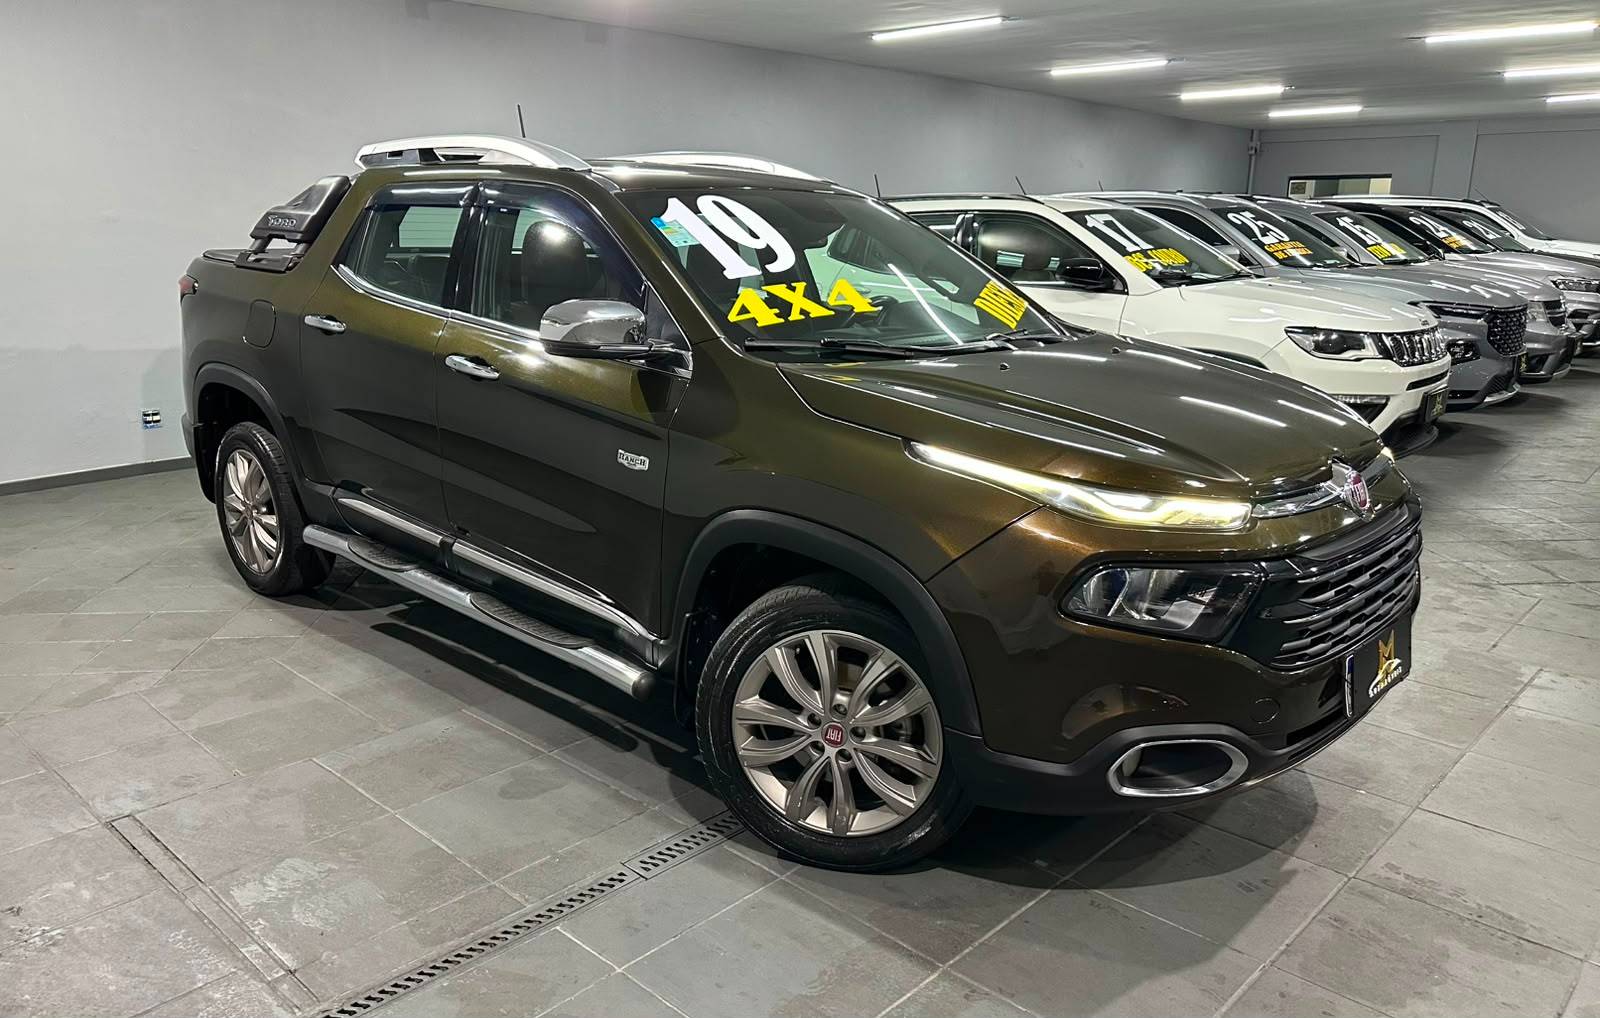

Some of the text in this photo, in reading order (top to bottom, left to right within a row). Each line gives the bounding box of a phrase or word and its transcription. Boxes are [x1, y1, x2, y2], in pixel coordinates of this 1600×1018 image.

[661, 194, 797, 280] 19
[1085, 213, 1154, 252] 17
[1227, 210, 1290, 244] 25
[1336, 216, 1383, 245] 15
[1409, 215, 1456, 238] 24
[727, 279, 882, 328] 4X4
[826, 728, 842, 742] FIAT
